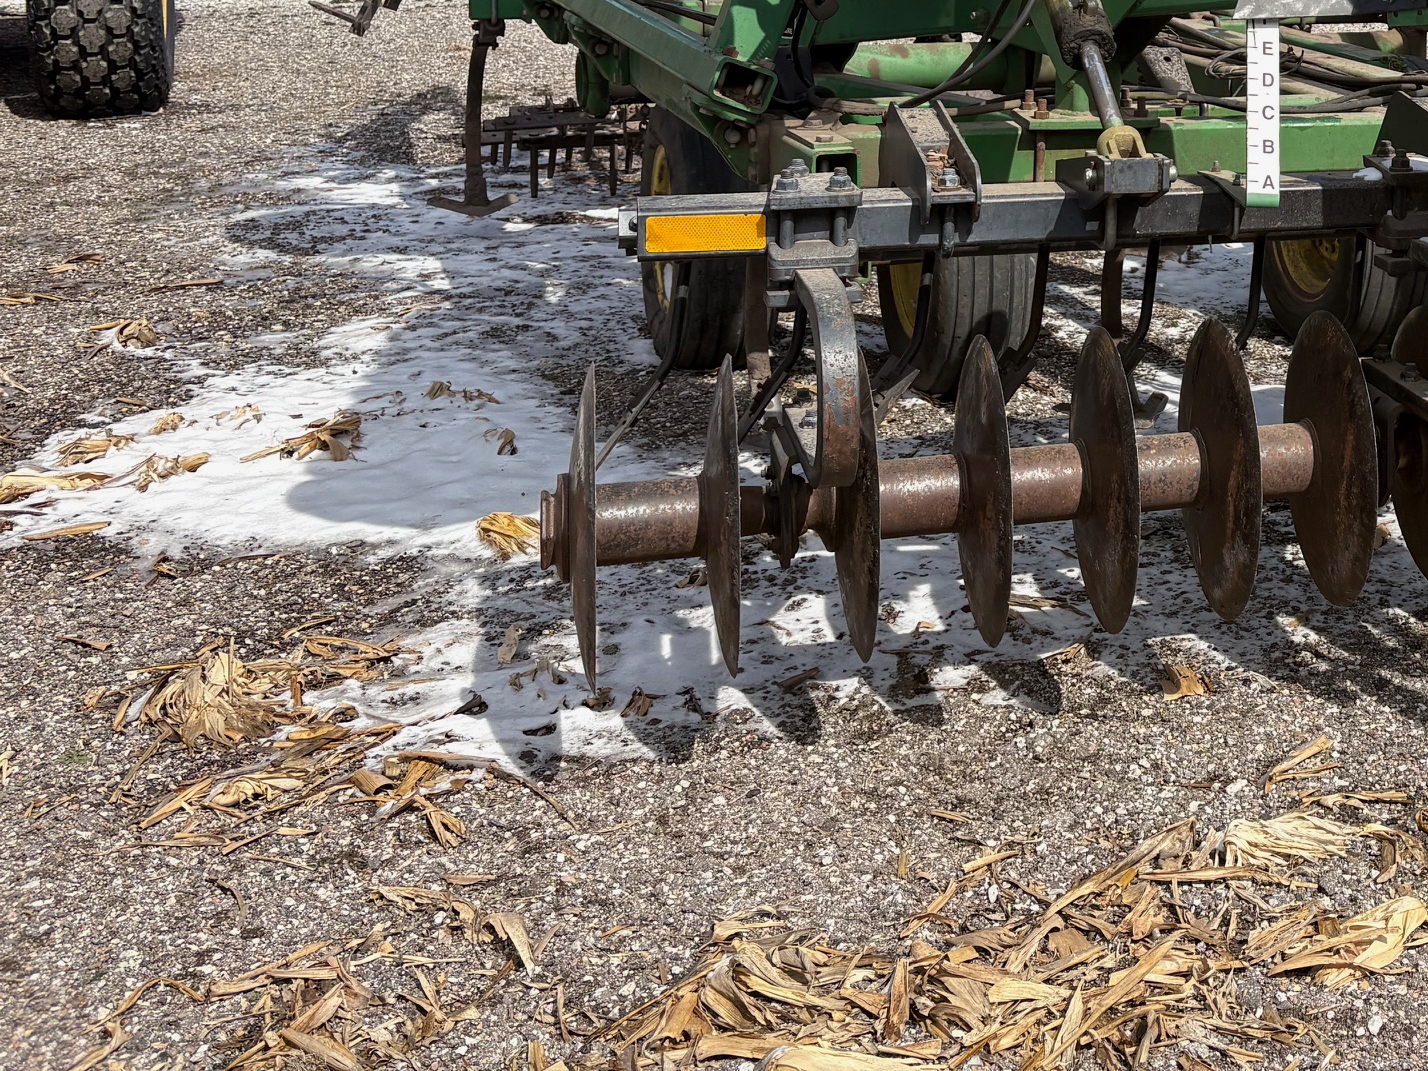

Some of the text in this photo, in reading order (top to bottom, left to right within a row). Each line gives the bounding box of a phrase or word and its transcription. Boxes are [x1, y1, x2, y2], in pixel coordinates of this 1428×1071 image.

[1262, 41, 1274, 56] E
[1262, 72, 1275, 87] D
[1261, 105, 1275, 120] C
[1262, 139, 1275, 154] B
[1262, 174, 1276, 190] A
